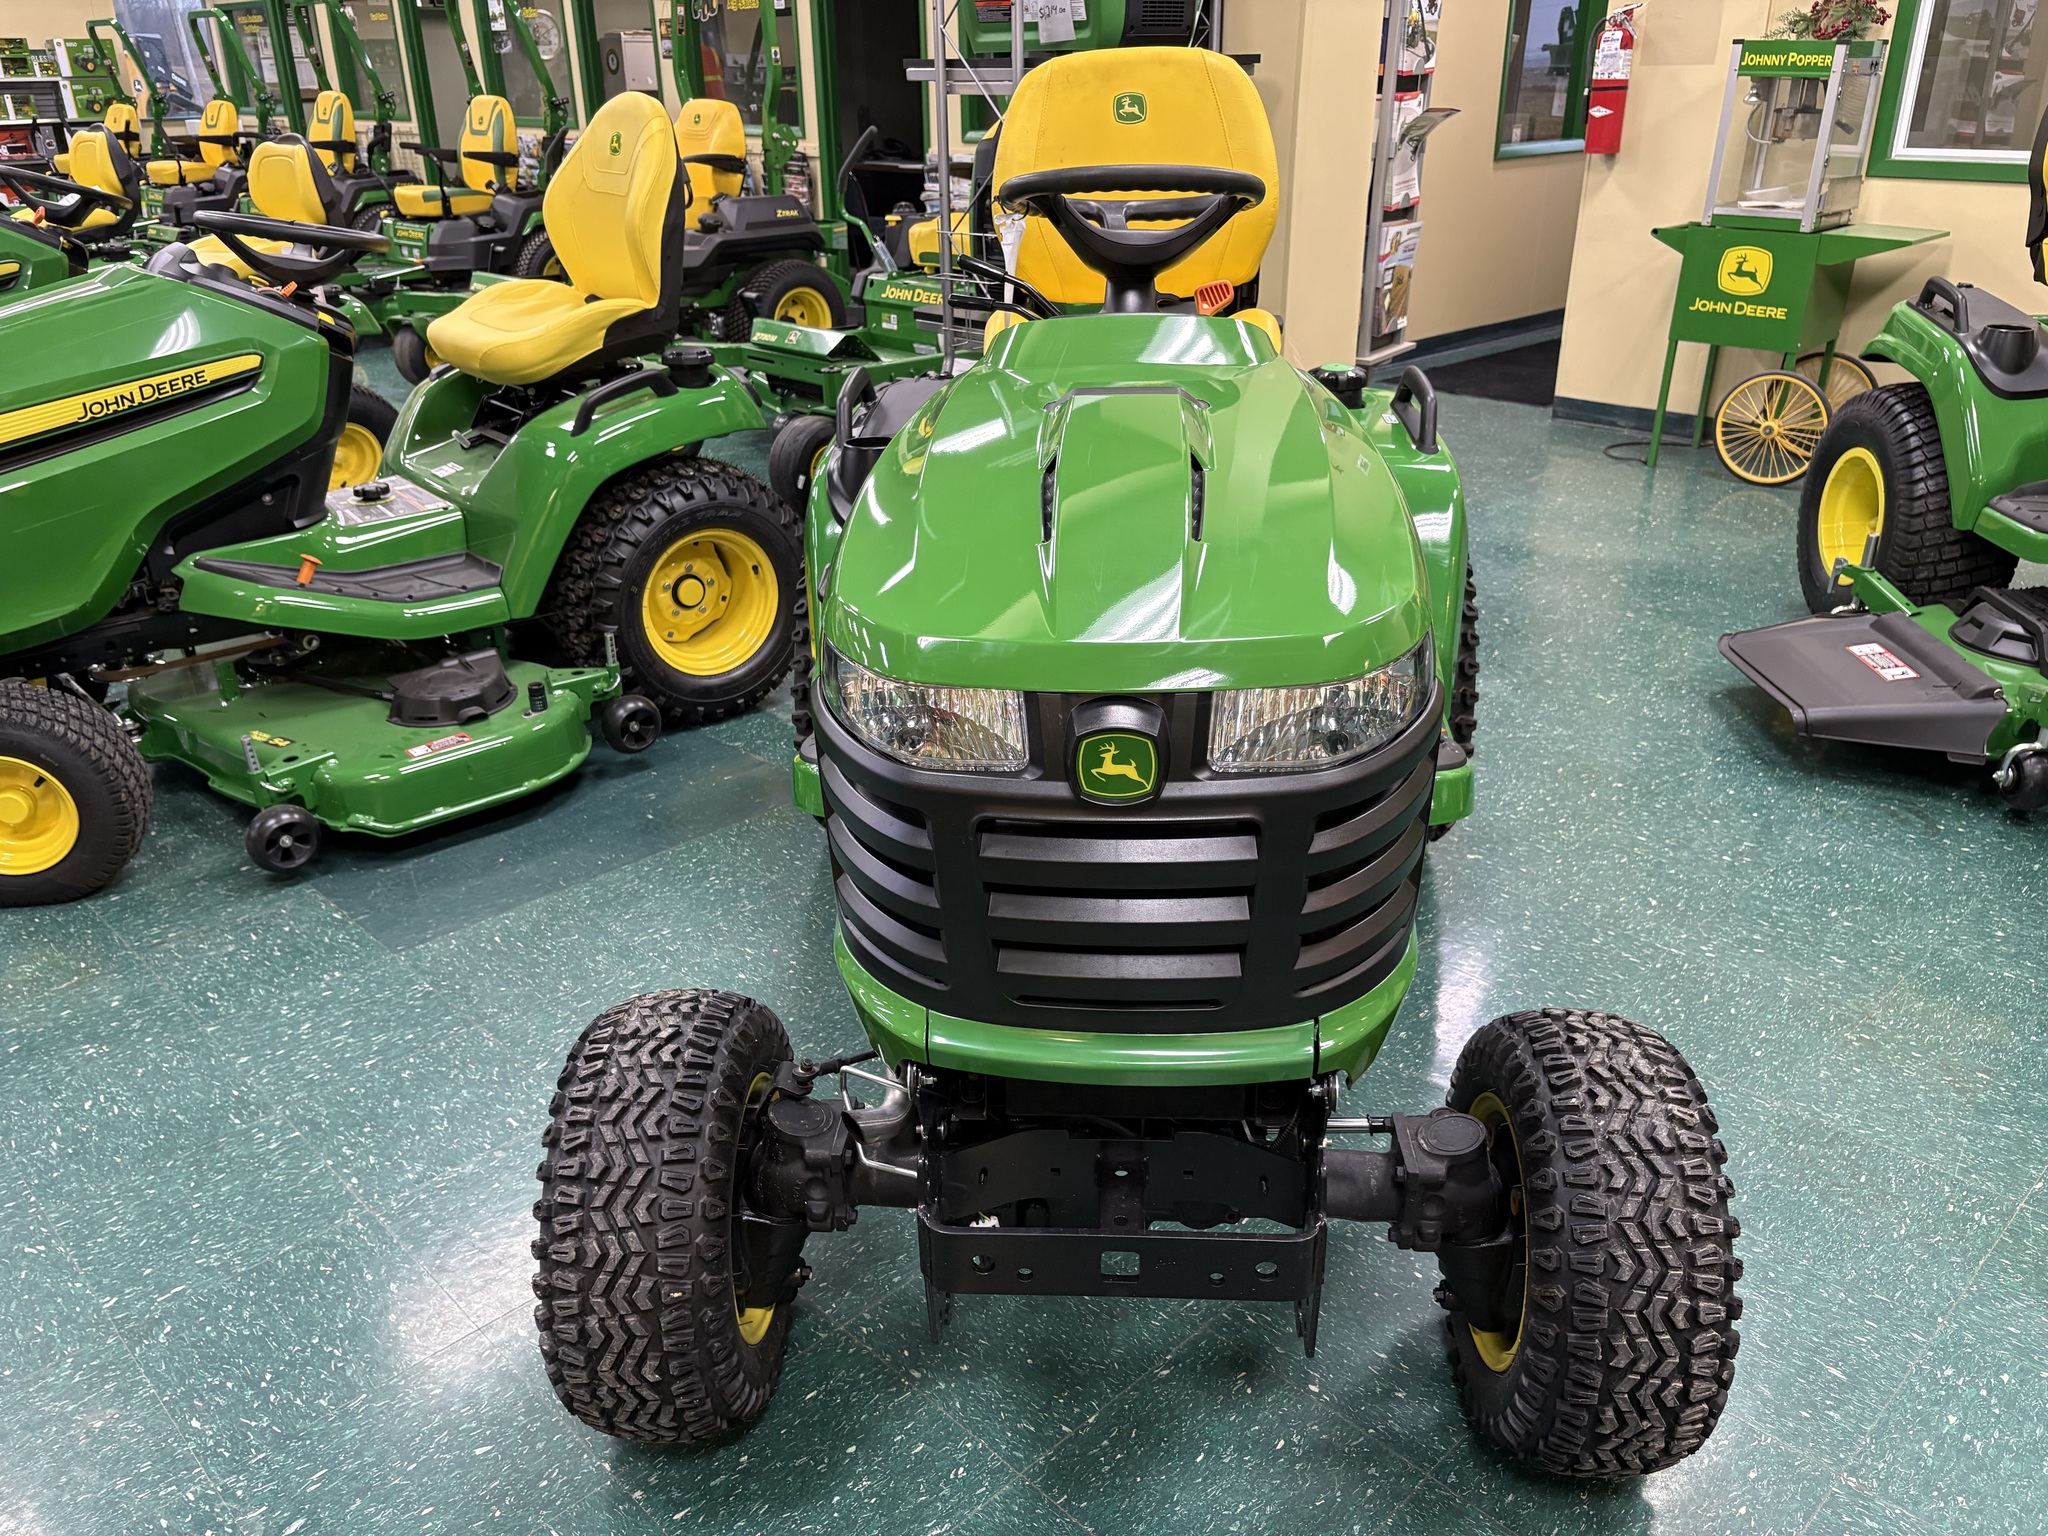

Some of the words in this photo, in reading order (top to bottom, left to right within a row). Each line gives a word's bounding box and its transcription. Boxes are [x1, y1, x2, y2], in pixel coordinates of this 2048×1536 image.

[1741, 52, 1787, 66] JOHNNY
[1787, 52, 1833, 67] POPPER
[881, 285, 913, 302] JOHN
[913, 288, 943, 305] DEER
[1689, 297, 1733, 314] JOHN
[1733, 301, 1788, 320] DEERE
[77, 391, 136, 421] JOHN
[139, 370, 208, 402] DEERE
